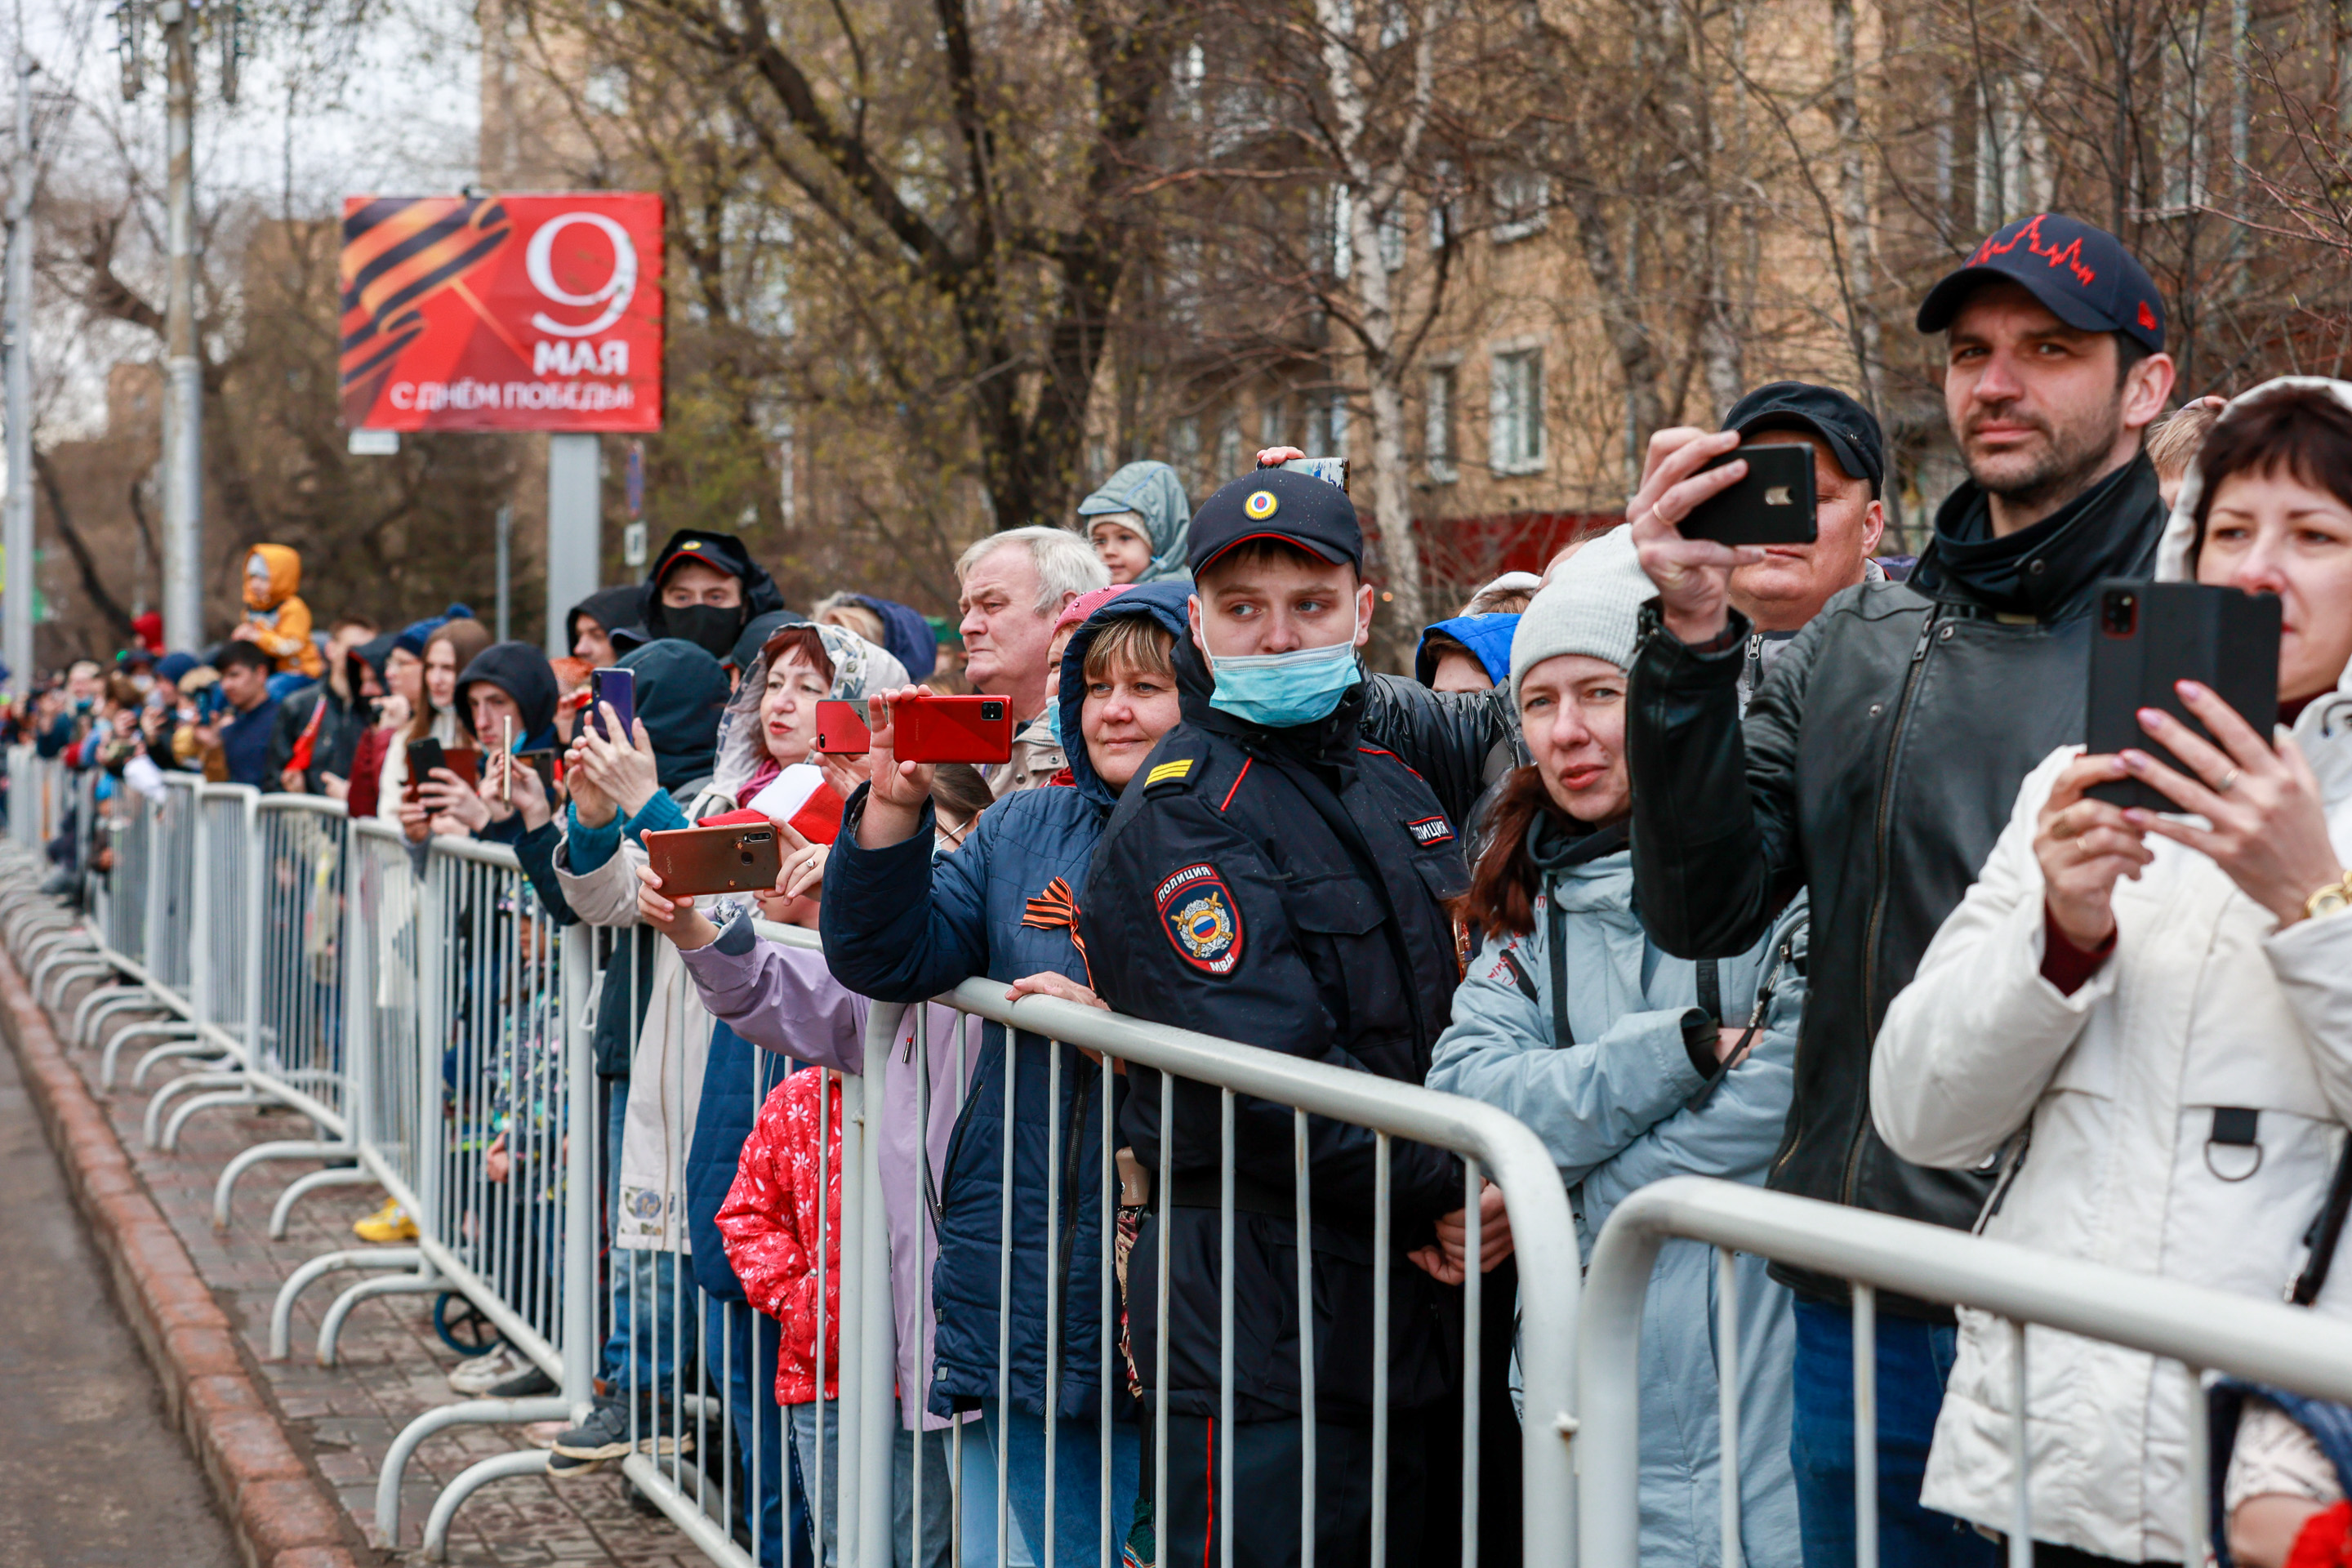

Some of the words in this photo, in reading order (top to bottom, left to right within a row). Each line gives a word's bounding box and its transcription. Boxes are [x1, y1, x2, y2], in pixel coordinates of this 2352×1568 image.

[526, 212, 638, 337] 9
[533, 340, 629, 376] МАЯ
[390, 381, 416, 409] С
[415, 376, 501, 412] ДНЁМ
[503, 380, 635, 412] ПОБЕДЫ
[1158, 866, 1211, 902] ПОЛИЦИЯ
[1209, 952, 1235, 972] МВД
